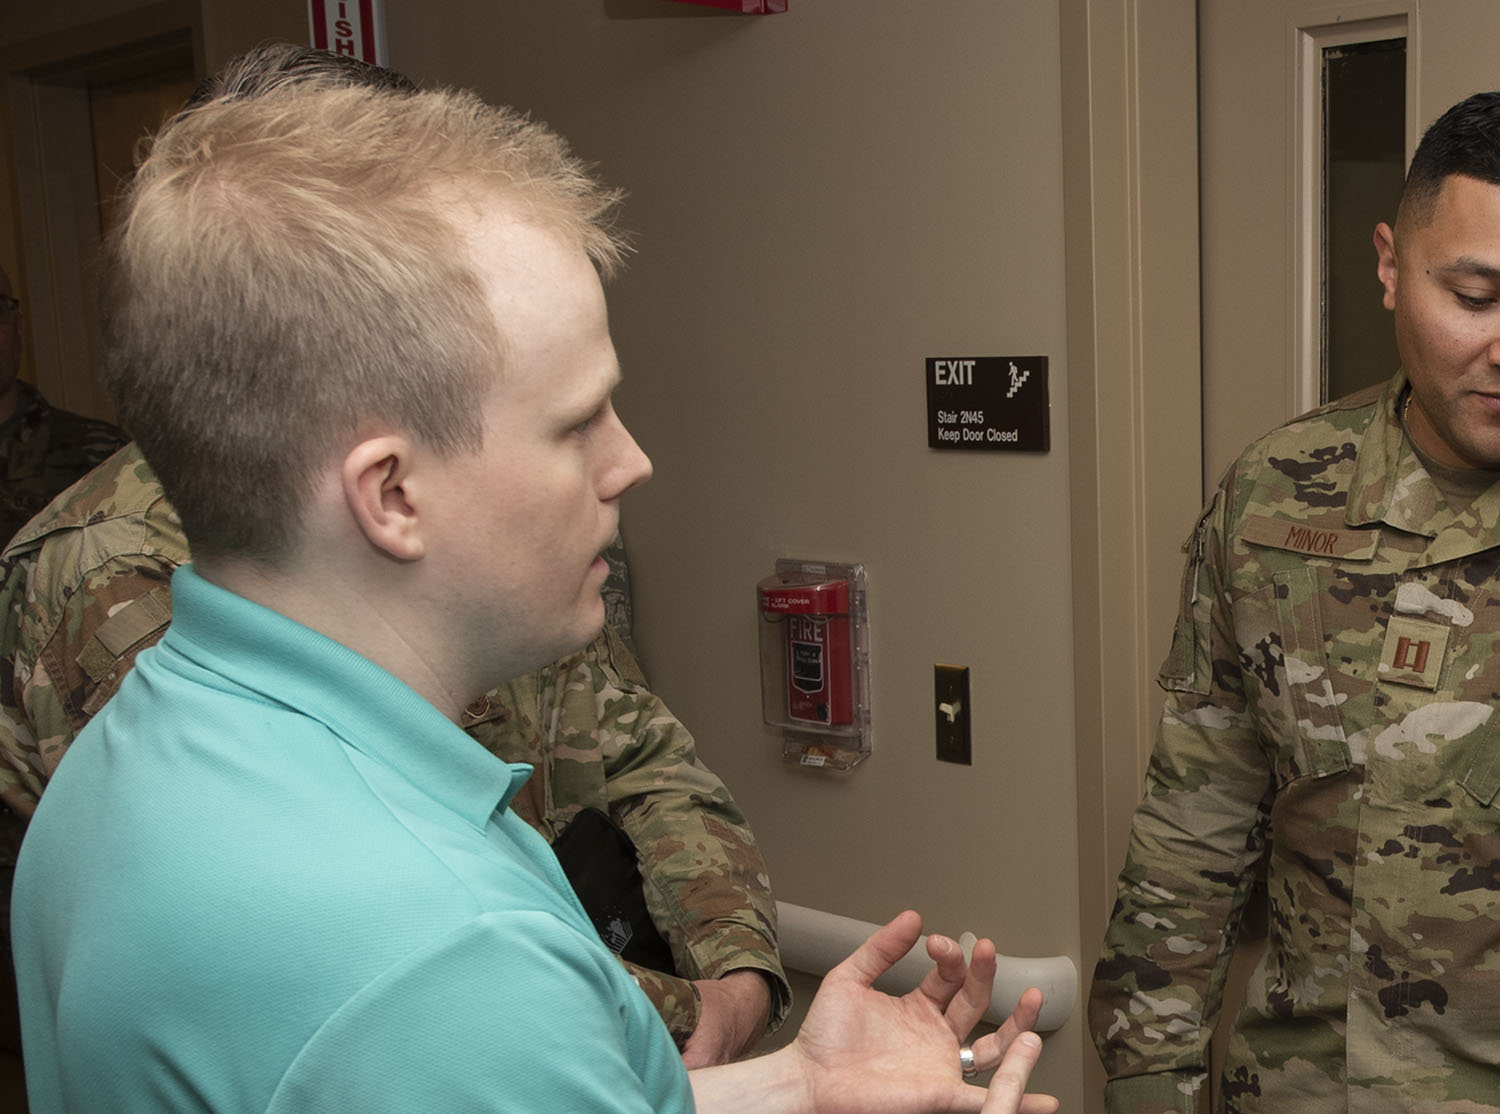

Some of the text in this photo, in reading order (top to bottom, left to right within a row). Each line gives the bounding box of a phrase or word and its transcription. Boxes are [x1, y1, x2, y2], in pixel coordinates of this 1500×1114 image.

[935, 360, 976, 385] EXIT
[937, 410, 984, 424] Stair 2N45
[937, 427, 1018, 443] Keep Door Closed
[1284, 526, 1338, 554] MINOR
[789, 616, 824, 642] FIRE
